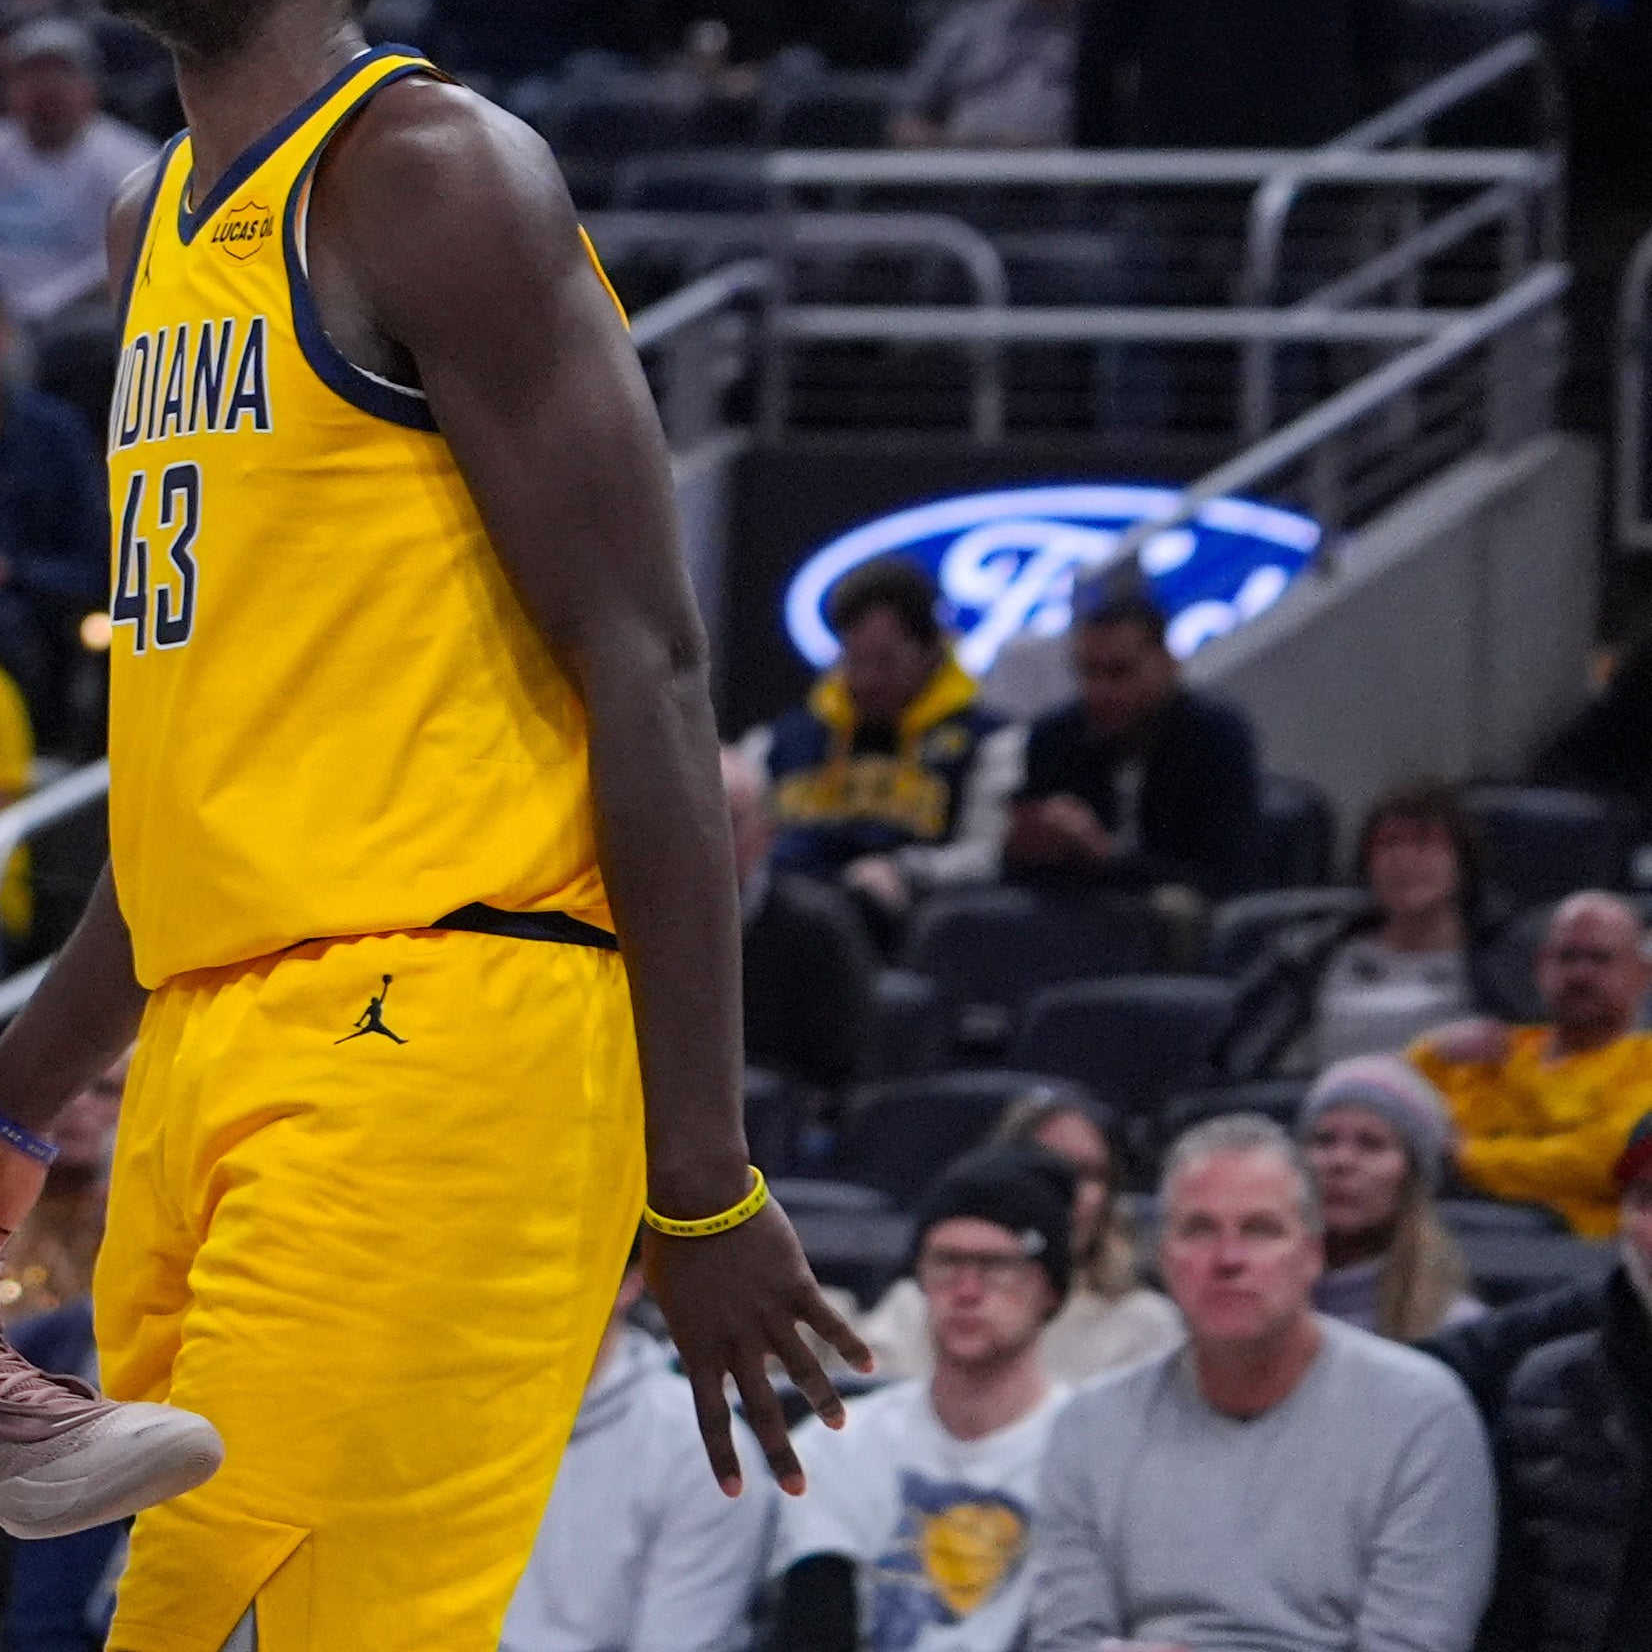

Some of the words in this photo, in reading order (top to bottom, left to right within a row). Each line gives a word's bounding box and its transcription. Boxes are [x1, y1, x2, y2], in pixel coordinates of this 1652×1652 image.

[210, 219, 259, 244] LUCAS
[107, 314, 274, 456] DIANA
[112, 460, 201, 657] 43
